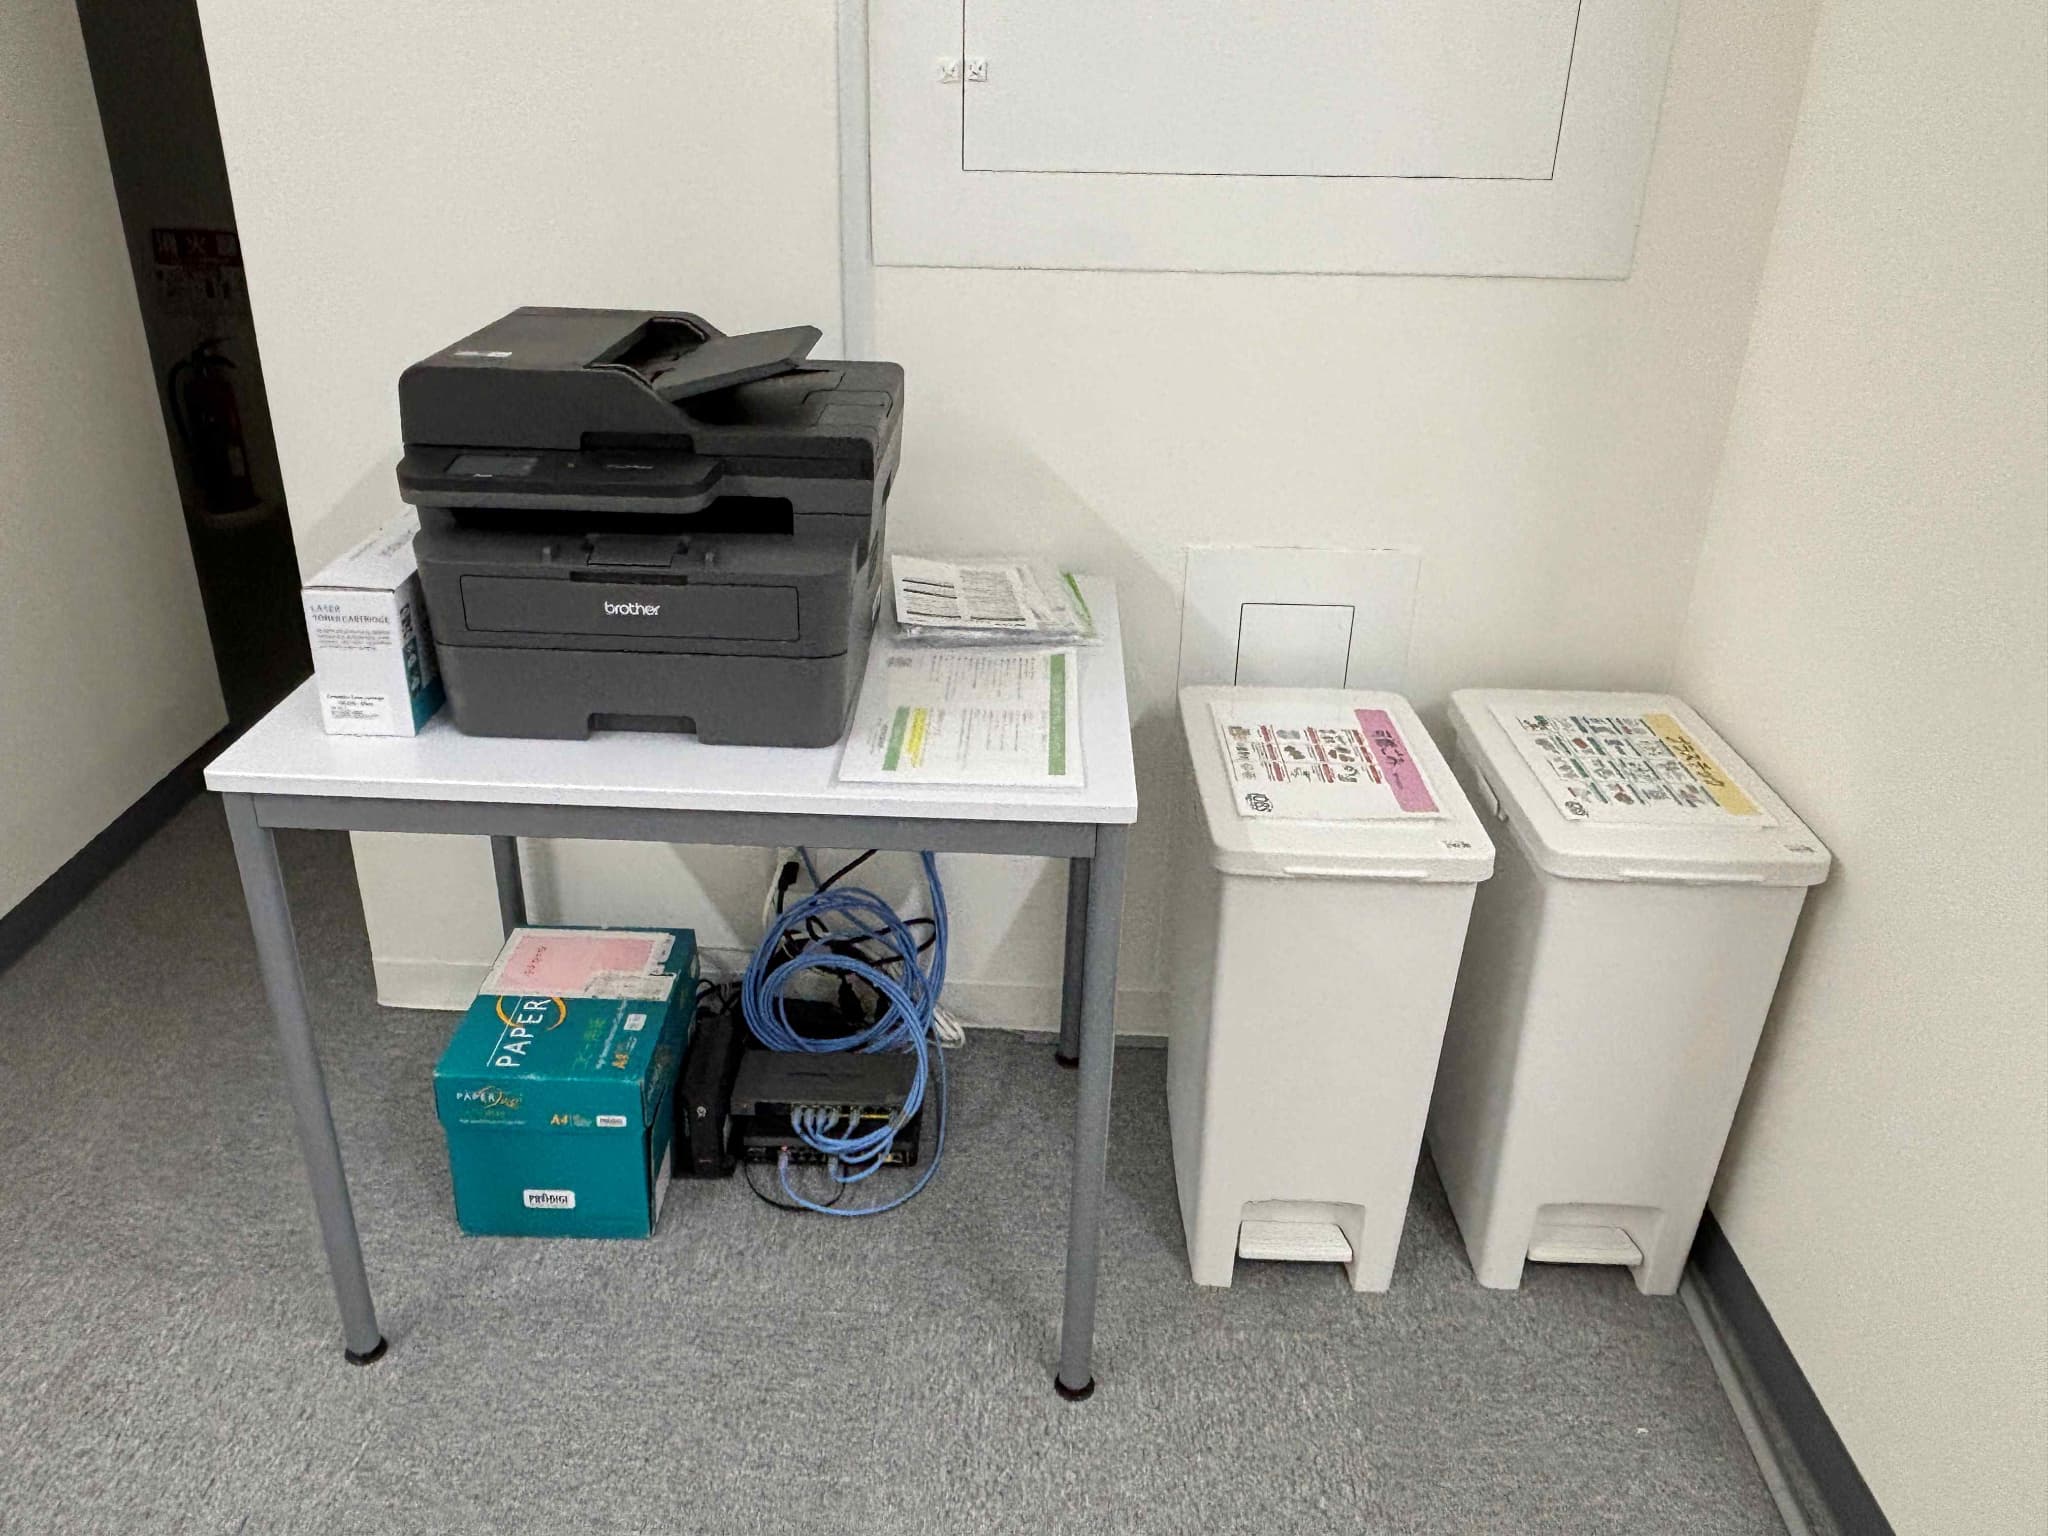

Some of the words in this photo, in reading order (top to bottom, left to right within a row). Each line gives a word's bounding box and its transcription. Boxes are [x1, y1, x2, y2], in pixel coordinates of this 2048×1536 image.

[604, 600, 661, 616] brother
[495, 999, 552, 1067] PAPER
[550, 1113, 569, 1126] A4
